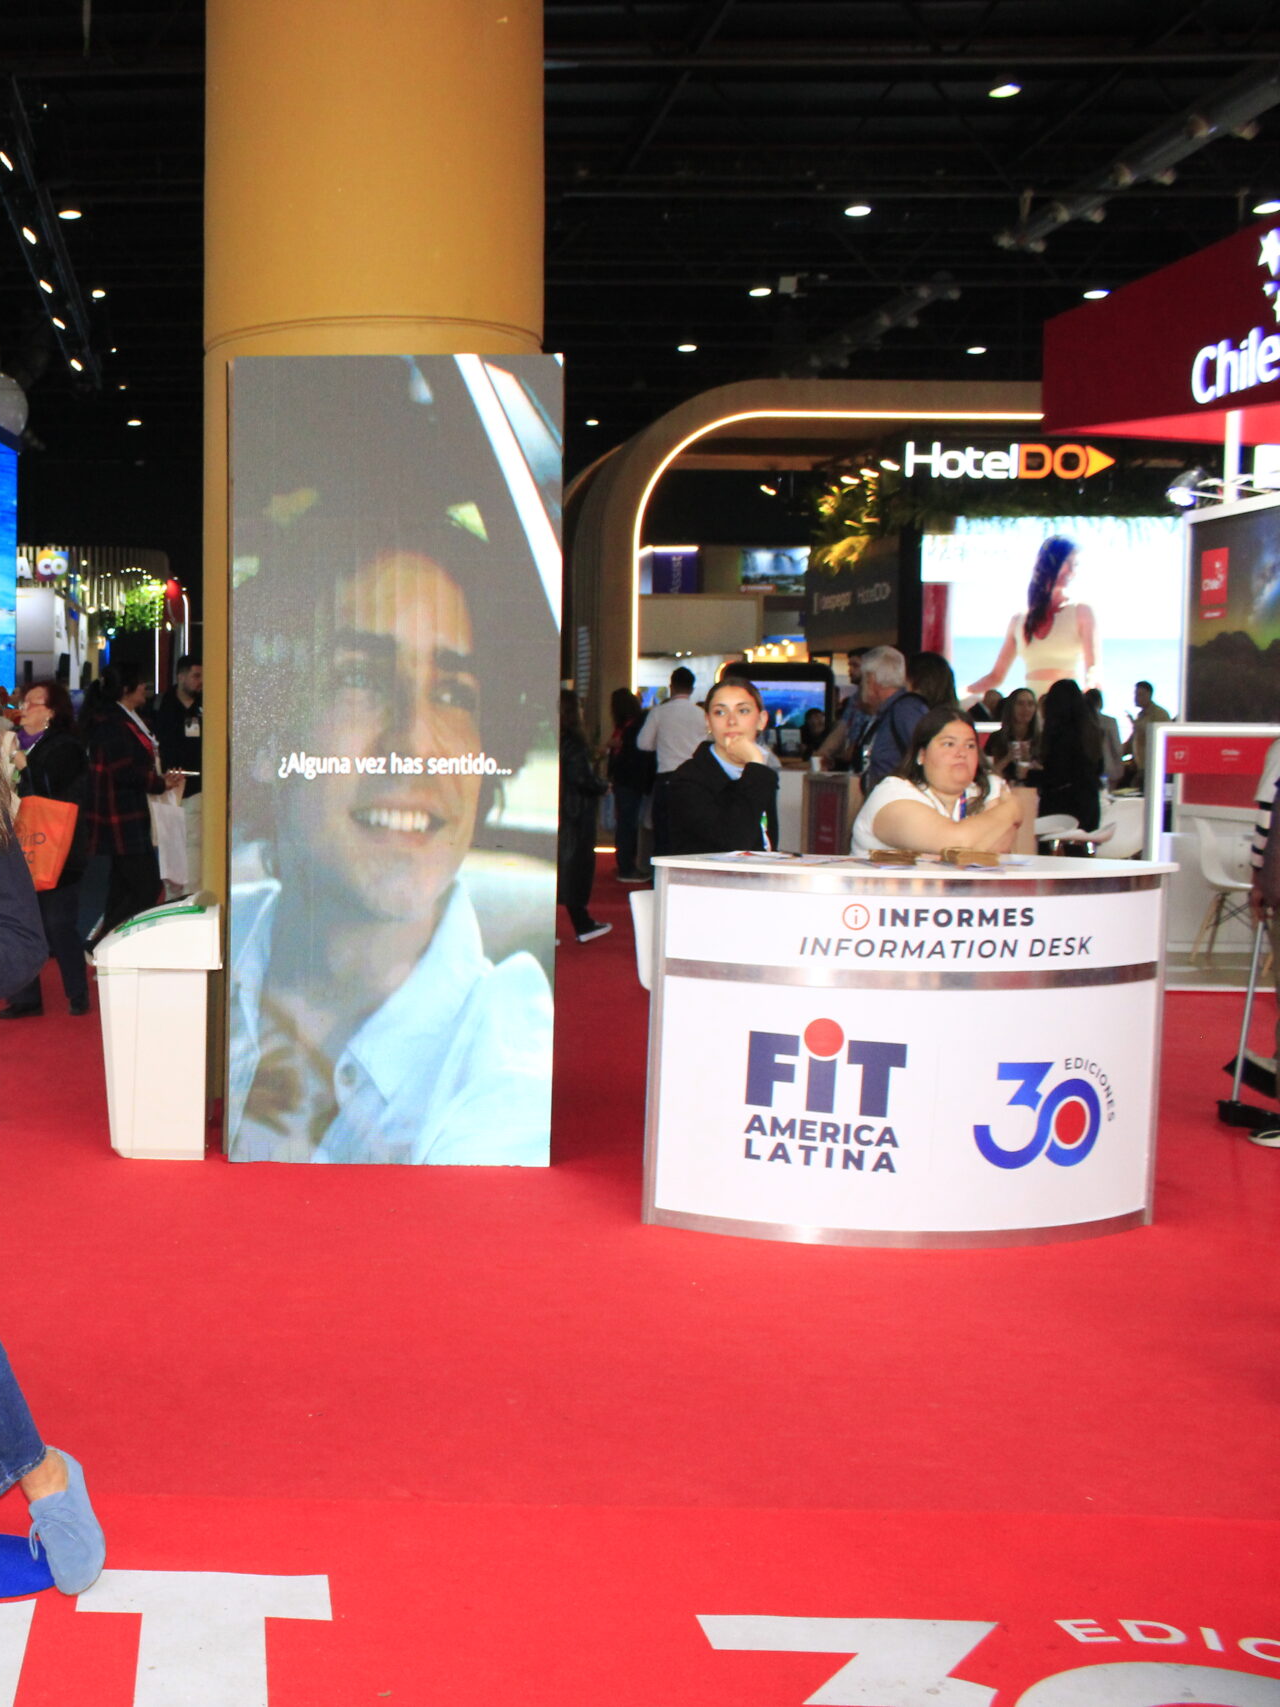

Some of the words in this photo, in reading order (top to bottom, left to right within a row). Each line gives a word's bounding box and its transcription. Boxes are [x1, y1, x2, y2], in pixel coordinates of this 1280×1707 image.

[1192, 327, 1280, 404] Chile
[905, 441, 1088, 480] HotelDO
[278, 752, 350, 779] ¿Alguna
[355, 757, 385, 775] vez
[390, 752, 423, 775] has
[427, 752, 512, 775] sentido...
[878, 906, 1035, 929] INFORMES
[799, 936, 1019, 959] INFORMATION
[1028, 935, 1093, 958] DESK
[1063, 1056, 1117, 1123] EDICIONES
[744, 1114, 899, 1149] AMERICA
[973, 1062, 1100, 1170] 30
[744, 1138, 897, 1173] LATINA
